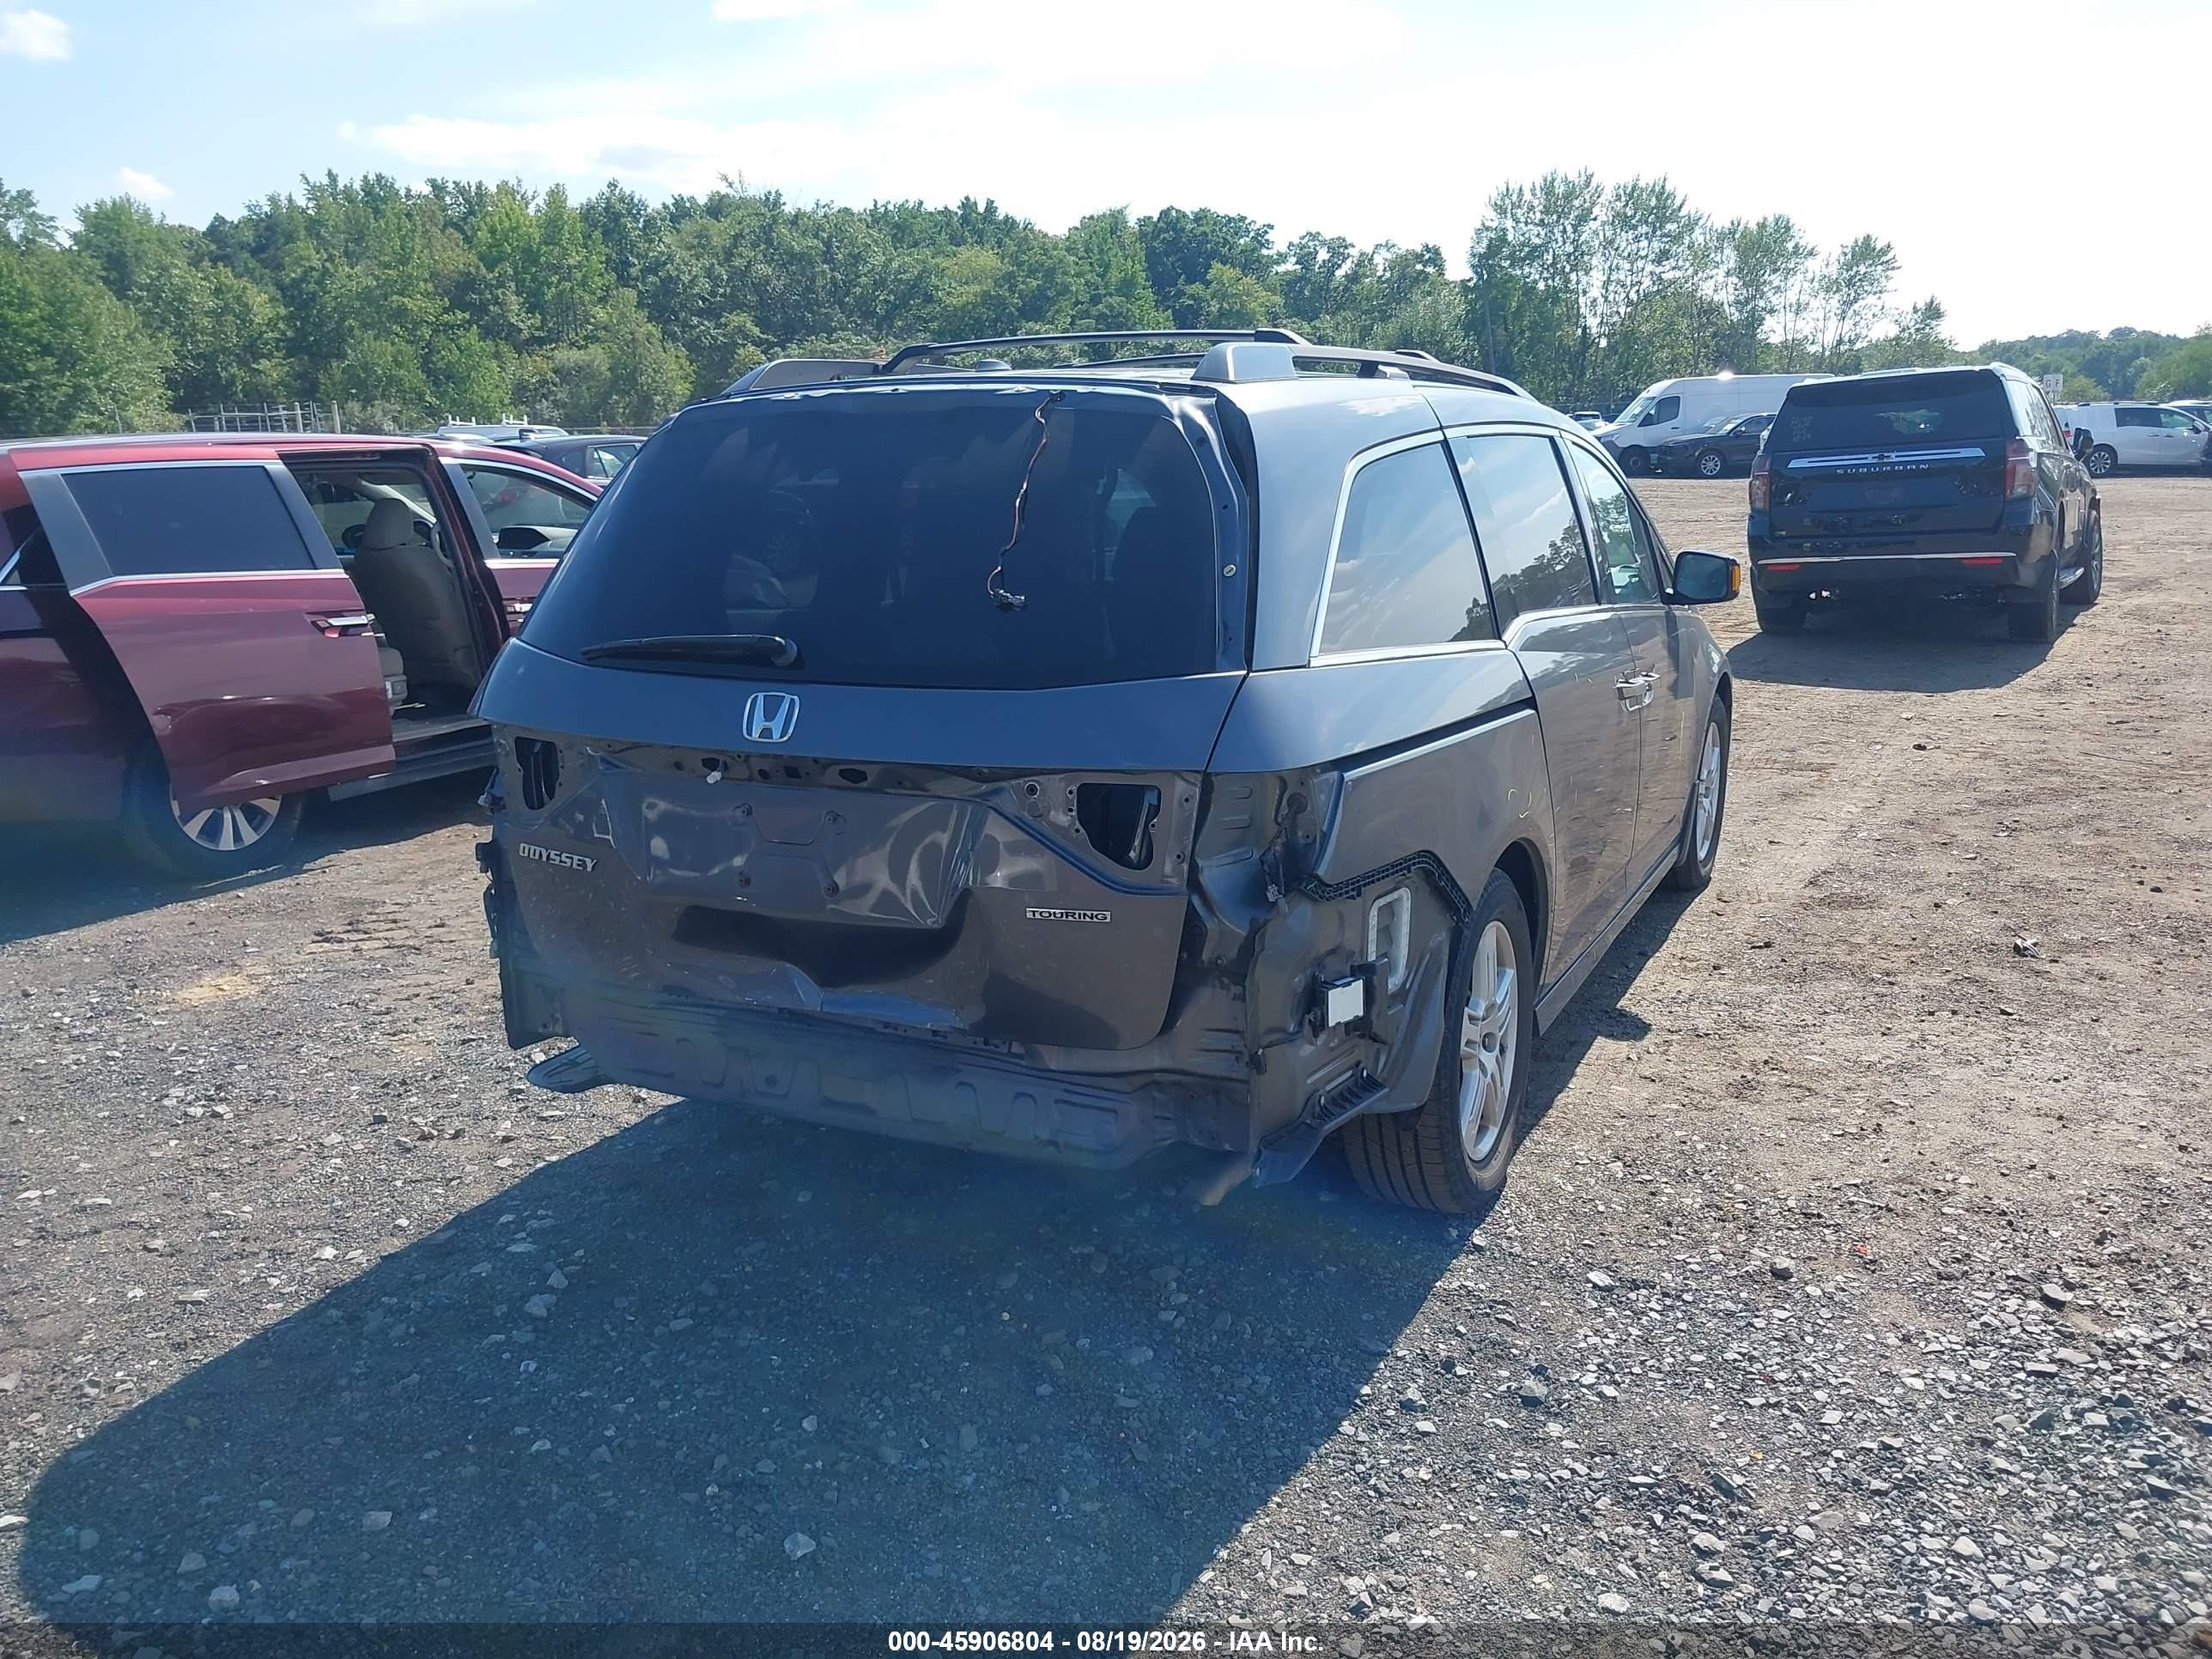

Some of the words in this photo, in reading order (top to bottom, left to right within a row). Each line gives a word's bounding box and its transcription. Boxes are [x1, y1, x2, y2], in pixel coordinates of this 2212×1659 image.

[2045, 379, 2051, 388] G
[2055, 379, 2060, 388] F
[1836, 464, 1929, 474] SUBURBAN
[519, 842, 597, 872] ODYSSEY
[1028, 909, 1108, 921] TOURING
